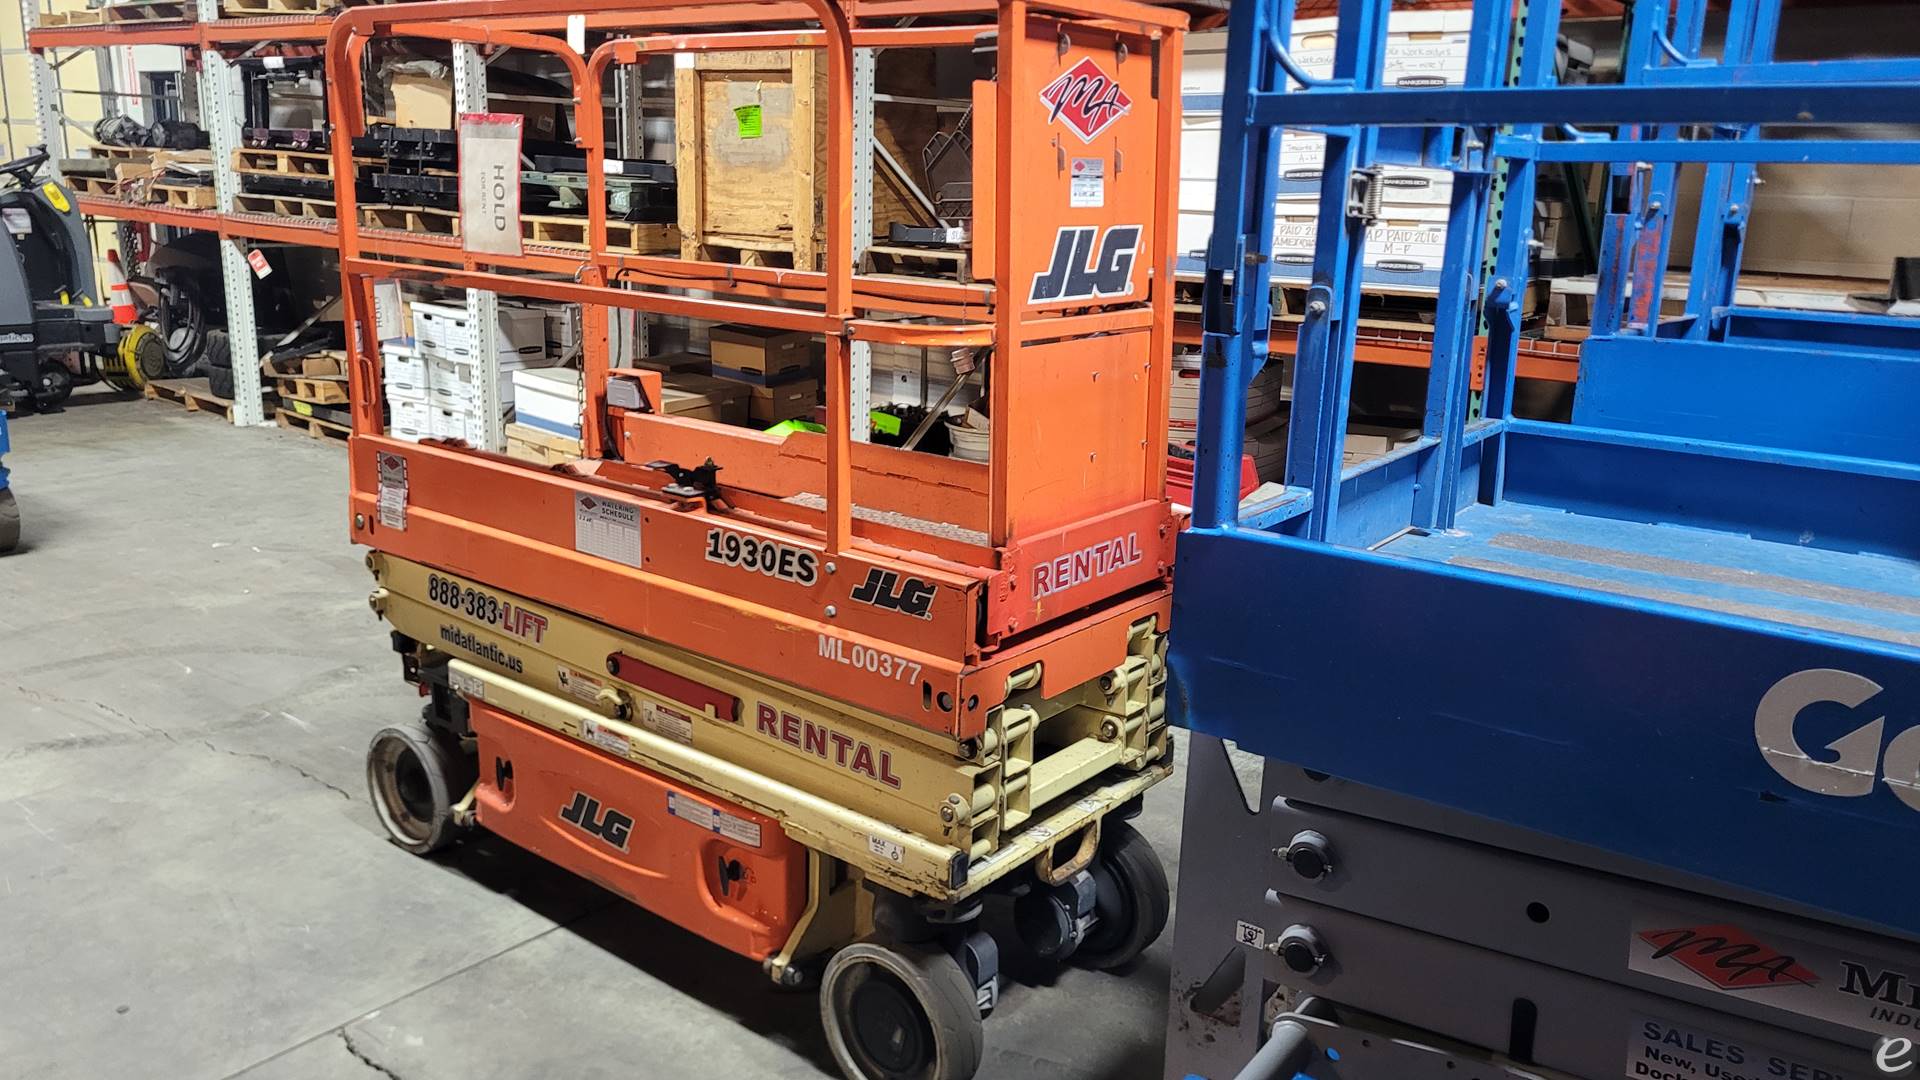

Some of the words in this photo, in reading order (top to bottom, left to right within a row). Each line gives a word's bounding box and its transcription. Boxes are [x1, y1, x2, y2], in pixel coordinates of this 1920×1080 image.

[493, 164, 506, 232] HOLD
[1387, 229, 1412, 242] PAID
[1414, 230, 1440, 243] 2016
[1027, 224, 1143, 304] JLG
[602, 508, 634, 521] SCHEDULE
[706, 529, 818, 587] 1930ES
[1032, 533, 1142, 599] RENTAL
[849, 567, 938, 620] JLG
[440, 625, 523, 673] midatlantic.us
[818, 634, 921, 685] ML00377
[757, 701, 901, 789] RENTAL
[558, 791, 635, 854] JLG
[1643, 1020, 1745, 1066] SALES
[1645, 1045, 1697, 1074] New,
